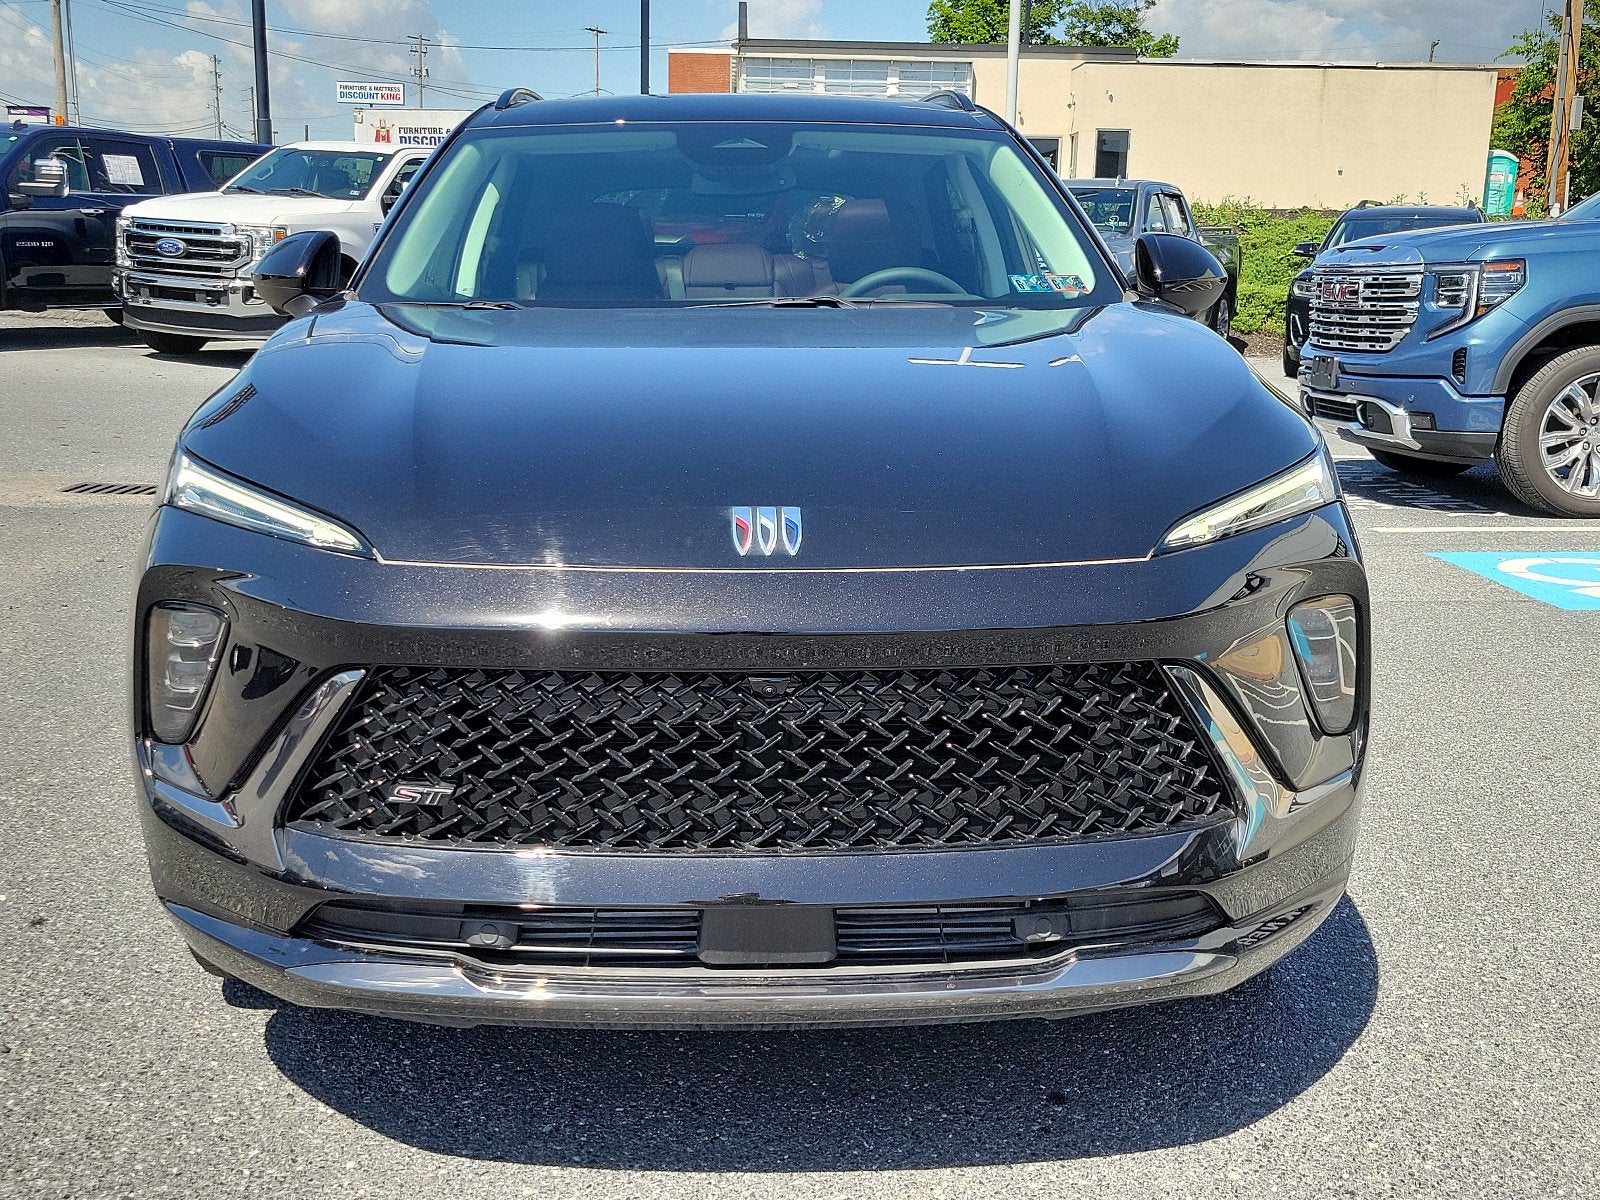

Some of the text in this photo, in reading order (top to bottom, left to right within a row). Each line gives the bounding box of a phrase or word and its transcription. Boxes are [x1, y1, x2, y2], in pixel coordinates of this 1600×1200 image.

[339, 84, 368, 92] FURNITURE
[339, 91, 401, 101] DISCOUNT KING
[398, 127, 443, 135] FURNITURE
[1323, 283, 1359, 301] GMC
[388, 786, 454, 806] ST
